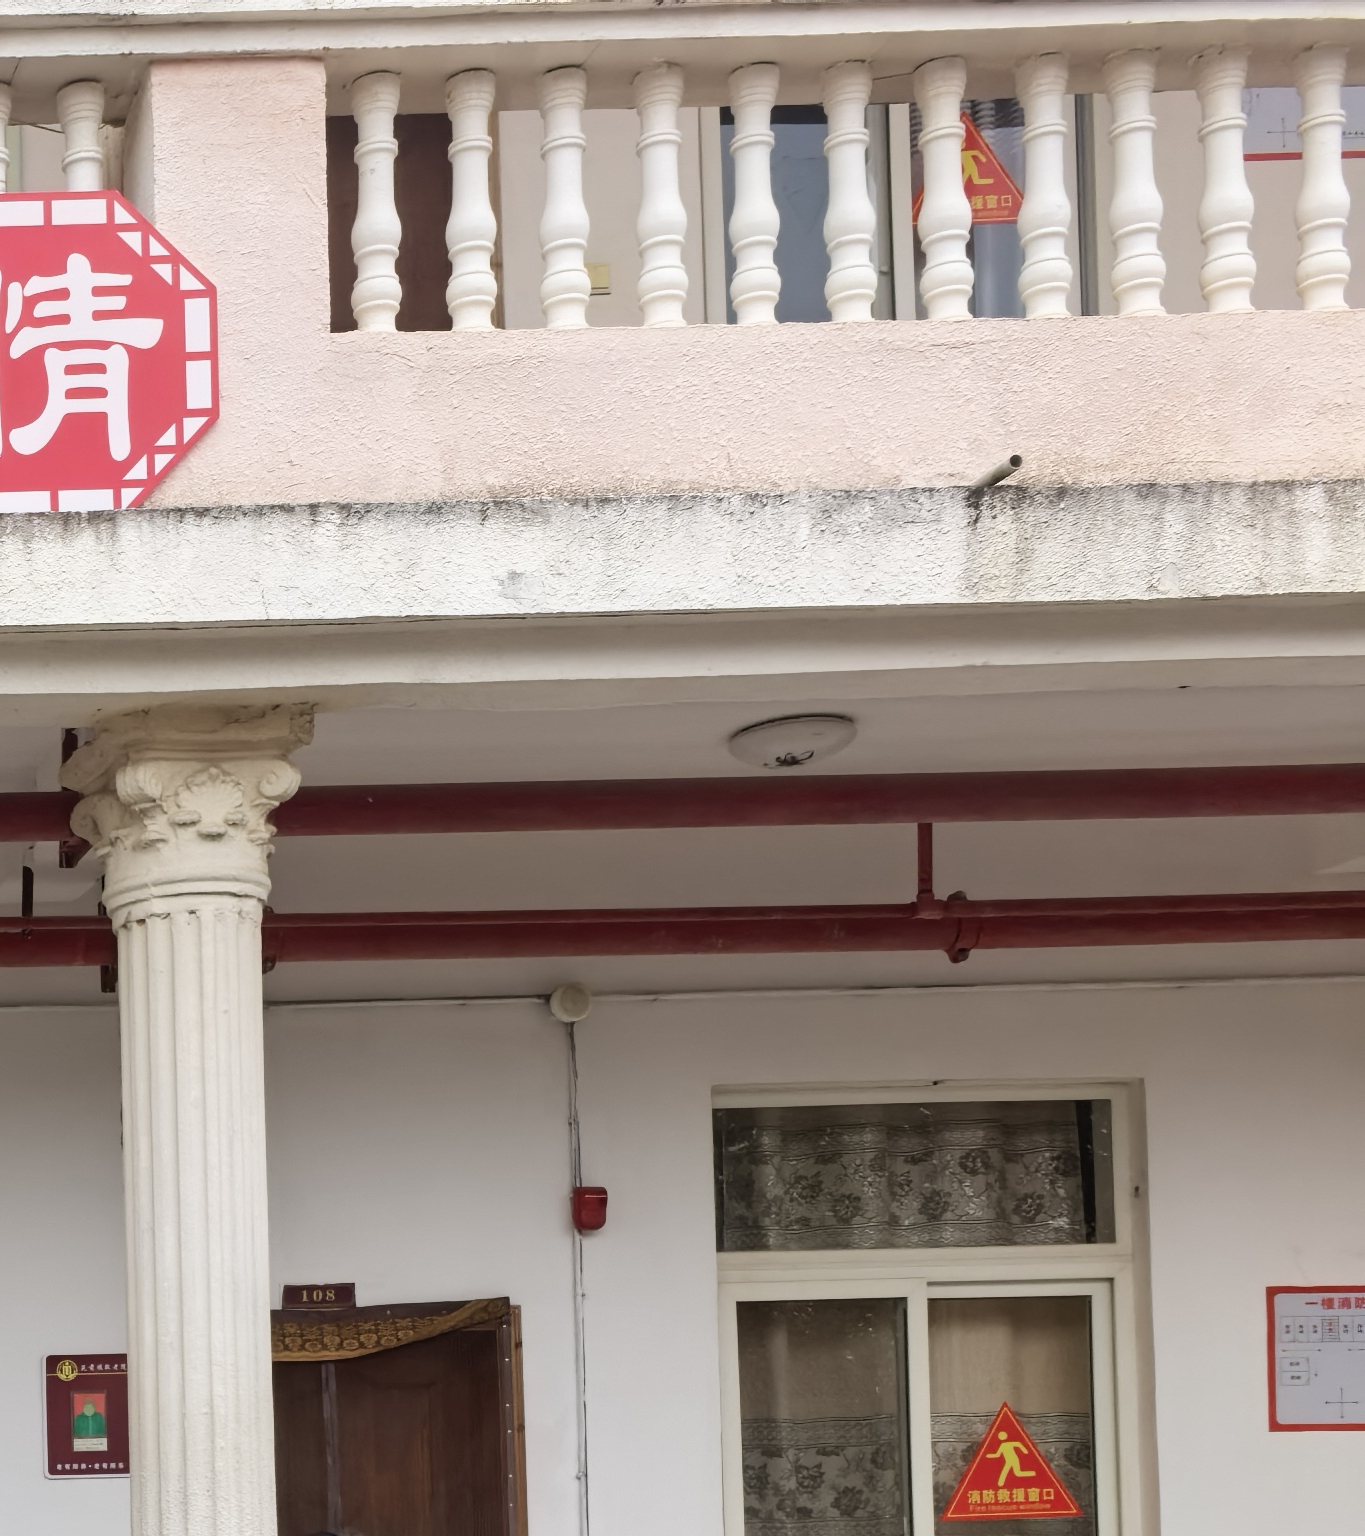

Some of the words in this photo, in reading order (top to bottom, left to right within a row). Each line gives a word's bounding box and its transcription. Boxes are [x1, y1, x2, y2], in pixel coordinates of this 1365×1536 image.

[301, 1288, 336, 1302] 108
[967, 1487, 1054, 1504] 消防救援窗口
